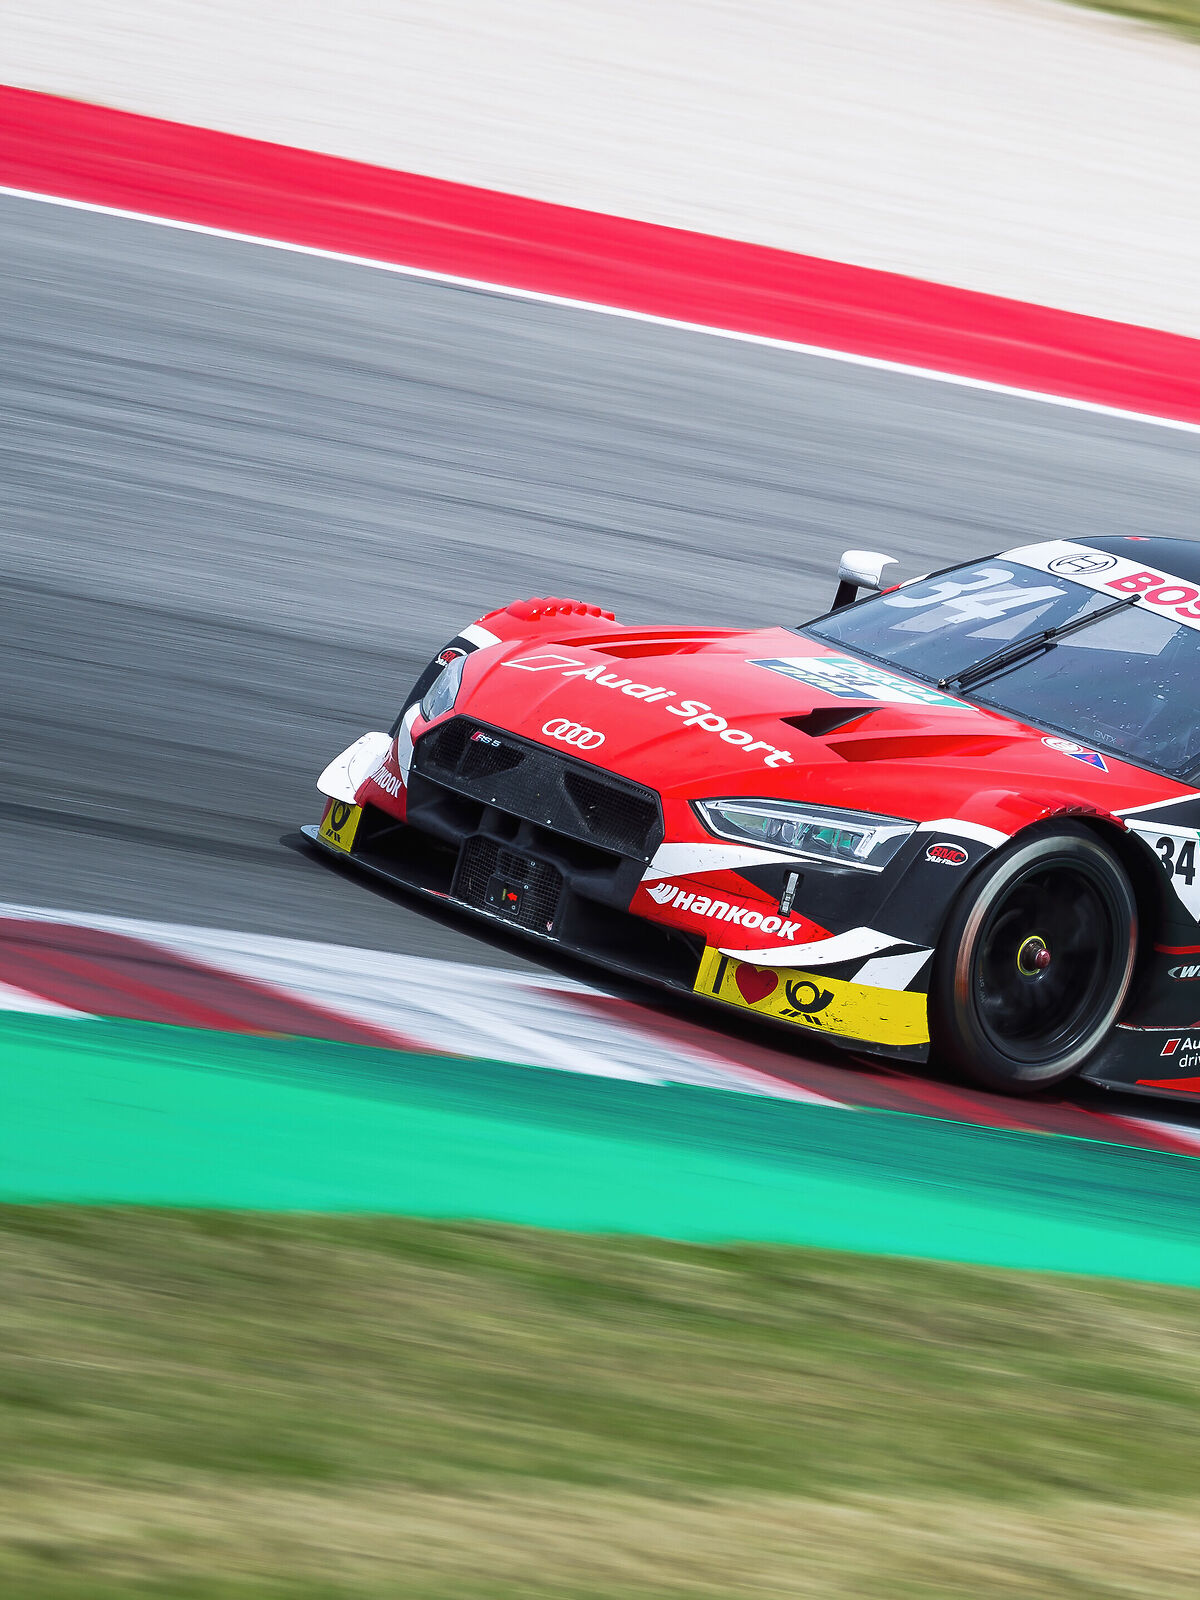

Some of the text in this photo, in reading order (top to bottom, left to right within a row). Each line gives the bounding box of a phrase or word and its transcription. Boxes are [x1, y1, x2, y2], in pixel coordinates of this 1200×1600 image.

[884, 566, 1068, 627] 34
[766, 665, 854, 692] DTM
[832, 662, 944, 702] DEKRA
[561, 664, 794, 768] Audi Sport
[491, 739, 502, 747] 5
[930, 846, 965, 862] BMC
[1155, 837, 1197, 887] 34
[712, 957, 729, 994] I
